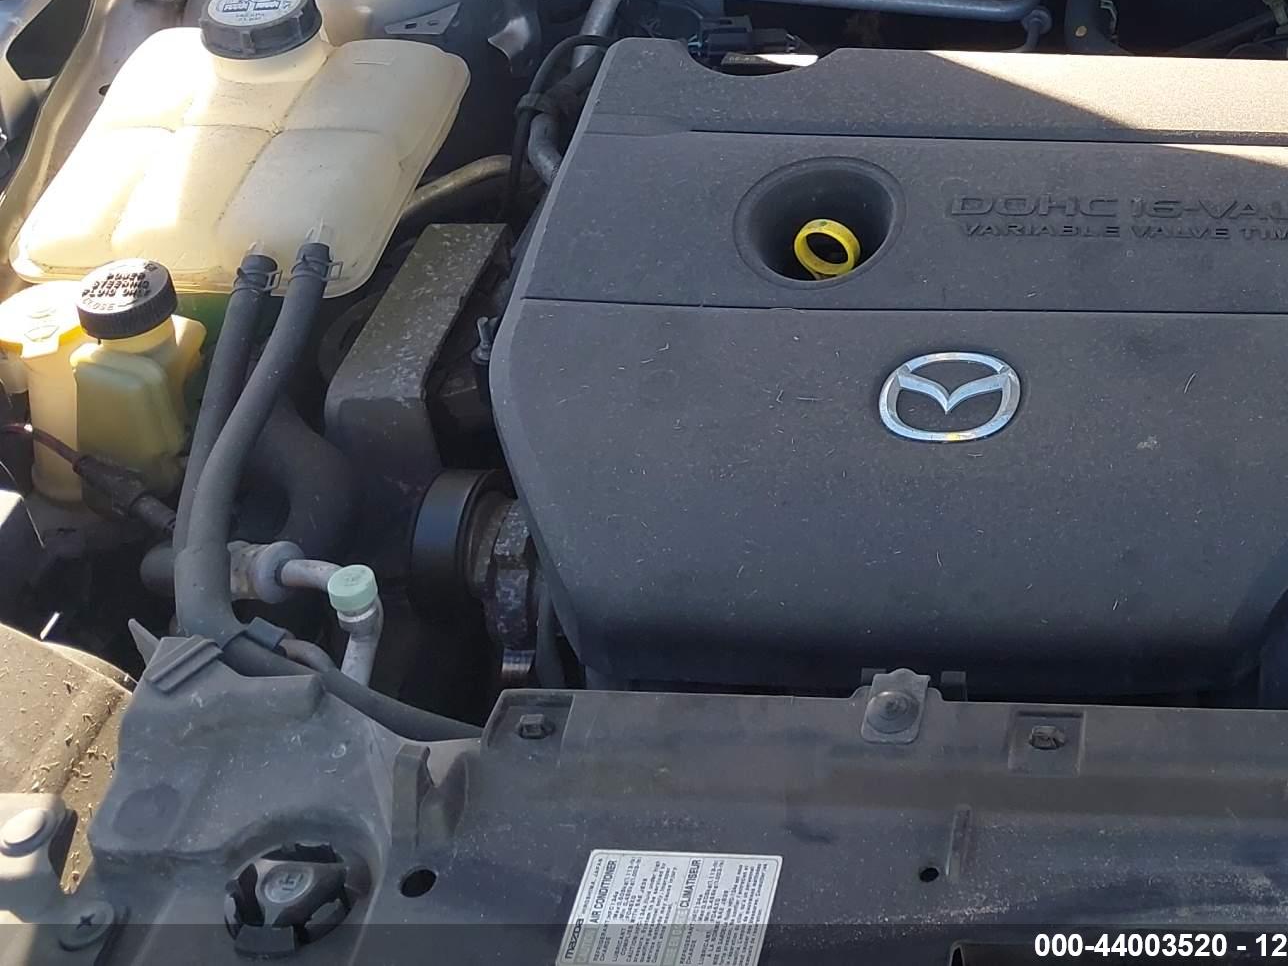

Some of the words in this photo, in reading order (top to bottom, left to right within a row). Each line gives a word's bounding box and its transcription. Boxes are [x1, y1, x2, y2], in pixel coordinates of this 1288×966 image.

[951, 195, 1118, 217] DOHC
[963, 223, 1121, 238] VARIABLE
[1130, 225, 1231, 240] VALVE
[590, 911, 602, 924] AIR
[597, 860, 617, 910] CONDITIONER
[680, 859, 702, 908] CLIMATISEUR
